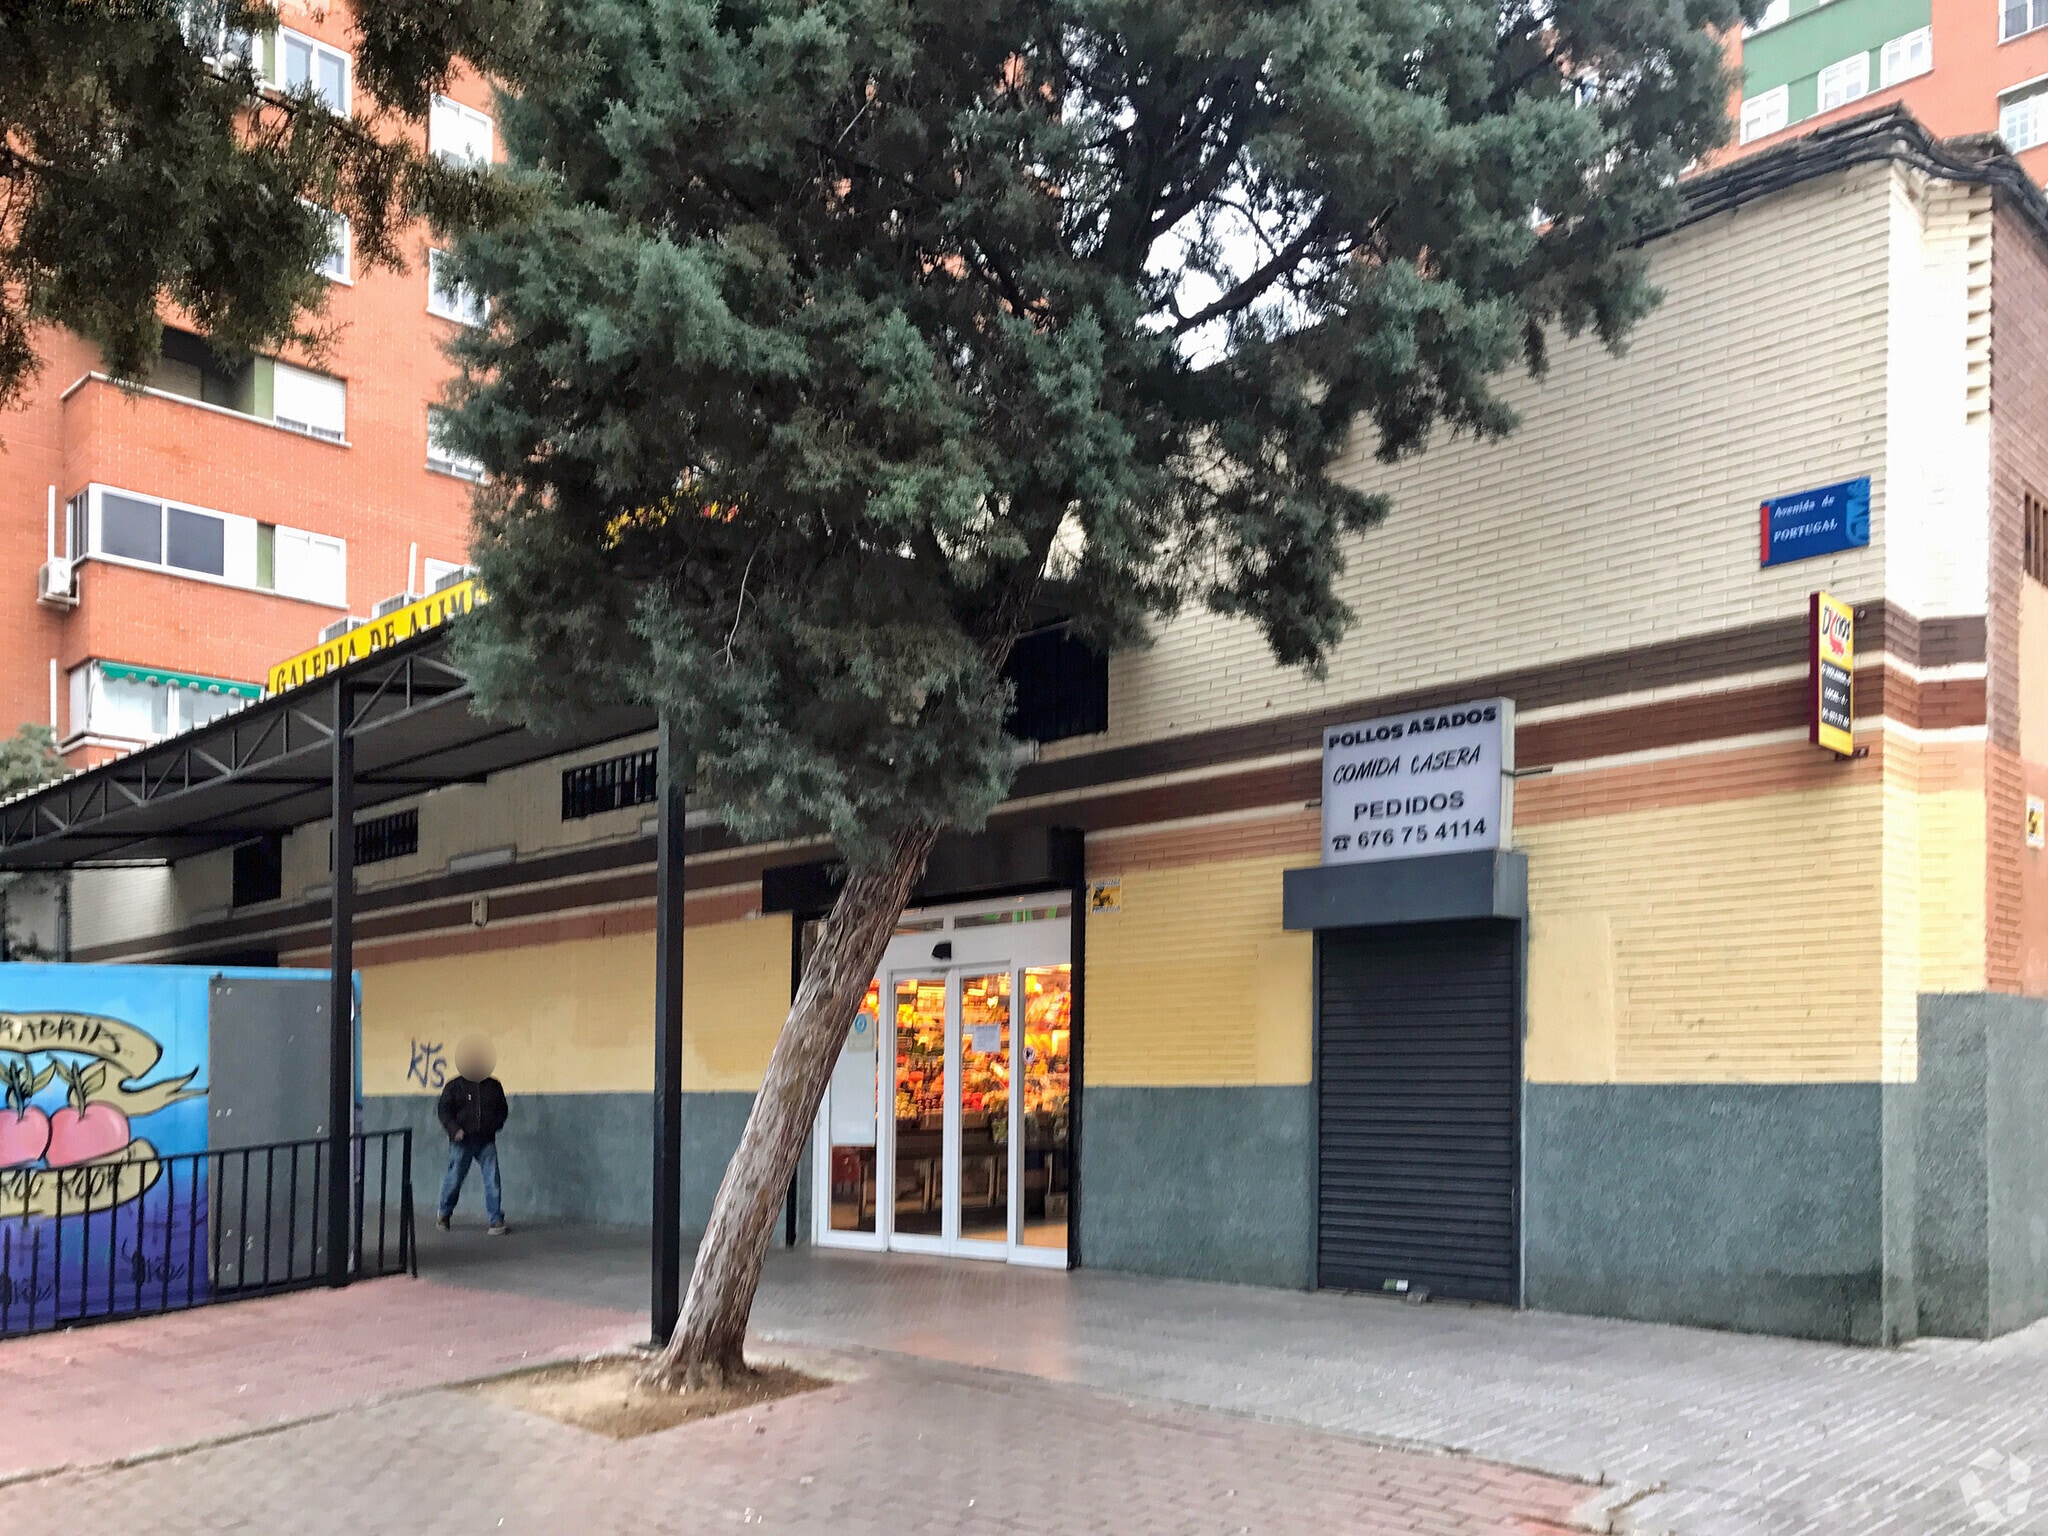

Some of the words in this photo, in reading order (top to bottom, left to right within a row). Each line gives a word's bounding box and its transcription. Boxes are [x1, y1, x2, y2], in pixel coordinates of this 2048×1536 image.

[1774, 499, 1816, 519] Avenida
[1821, 494, 1835, 508] de
[1773, 518, 1838, 543] PORTUGAL
[369, 619, 397, 650] DE
[1328, 723, 1403, 749] POLLOS
[1408, 706, 1497, 735] ASADOS
[1333, 755, 1400, 785] COMIDA
[1410, 743, 1482, 776] CASERA
[1354, 790, 1465, 822] PEDIDOS
[1358, 827, 1394, 849] 676
[1401, 825, 1428, 844] 75
[1434, 817, 1487, 840] 4114
